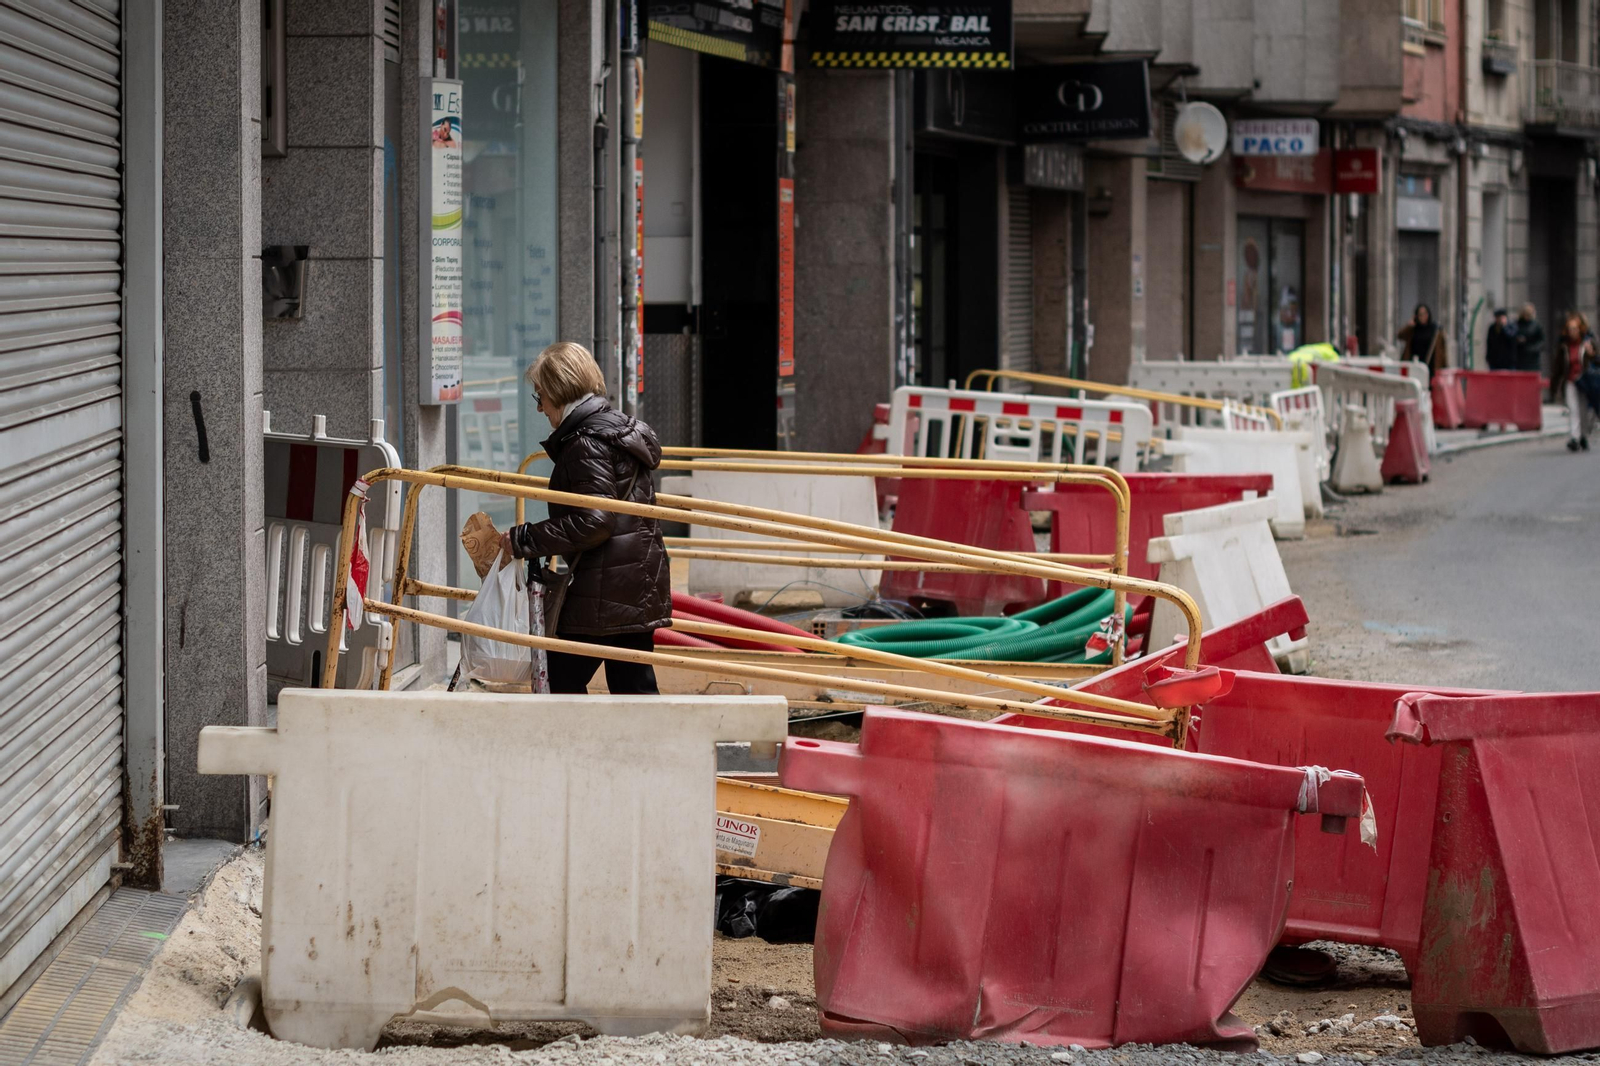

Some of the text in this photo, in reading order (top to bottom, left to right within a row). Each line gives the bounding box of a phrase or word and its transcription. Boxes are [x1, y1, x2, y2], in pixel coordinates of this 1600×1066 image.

[836, 15, 876, 32] SAN
[935, 37, 992, 46] MECANICA
[1243, 137, 1304, 153] PACO
